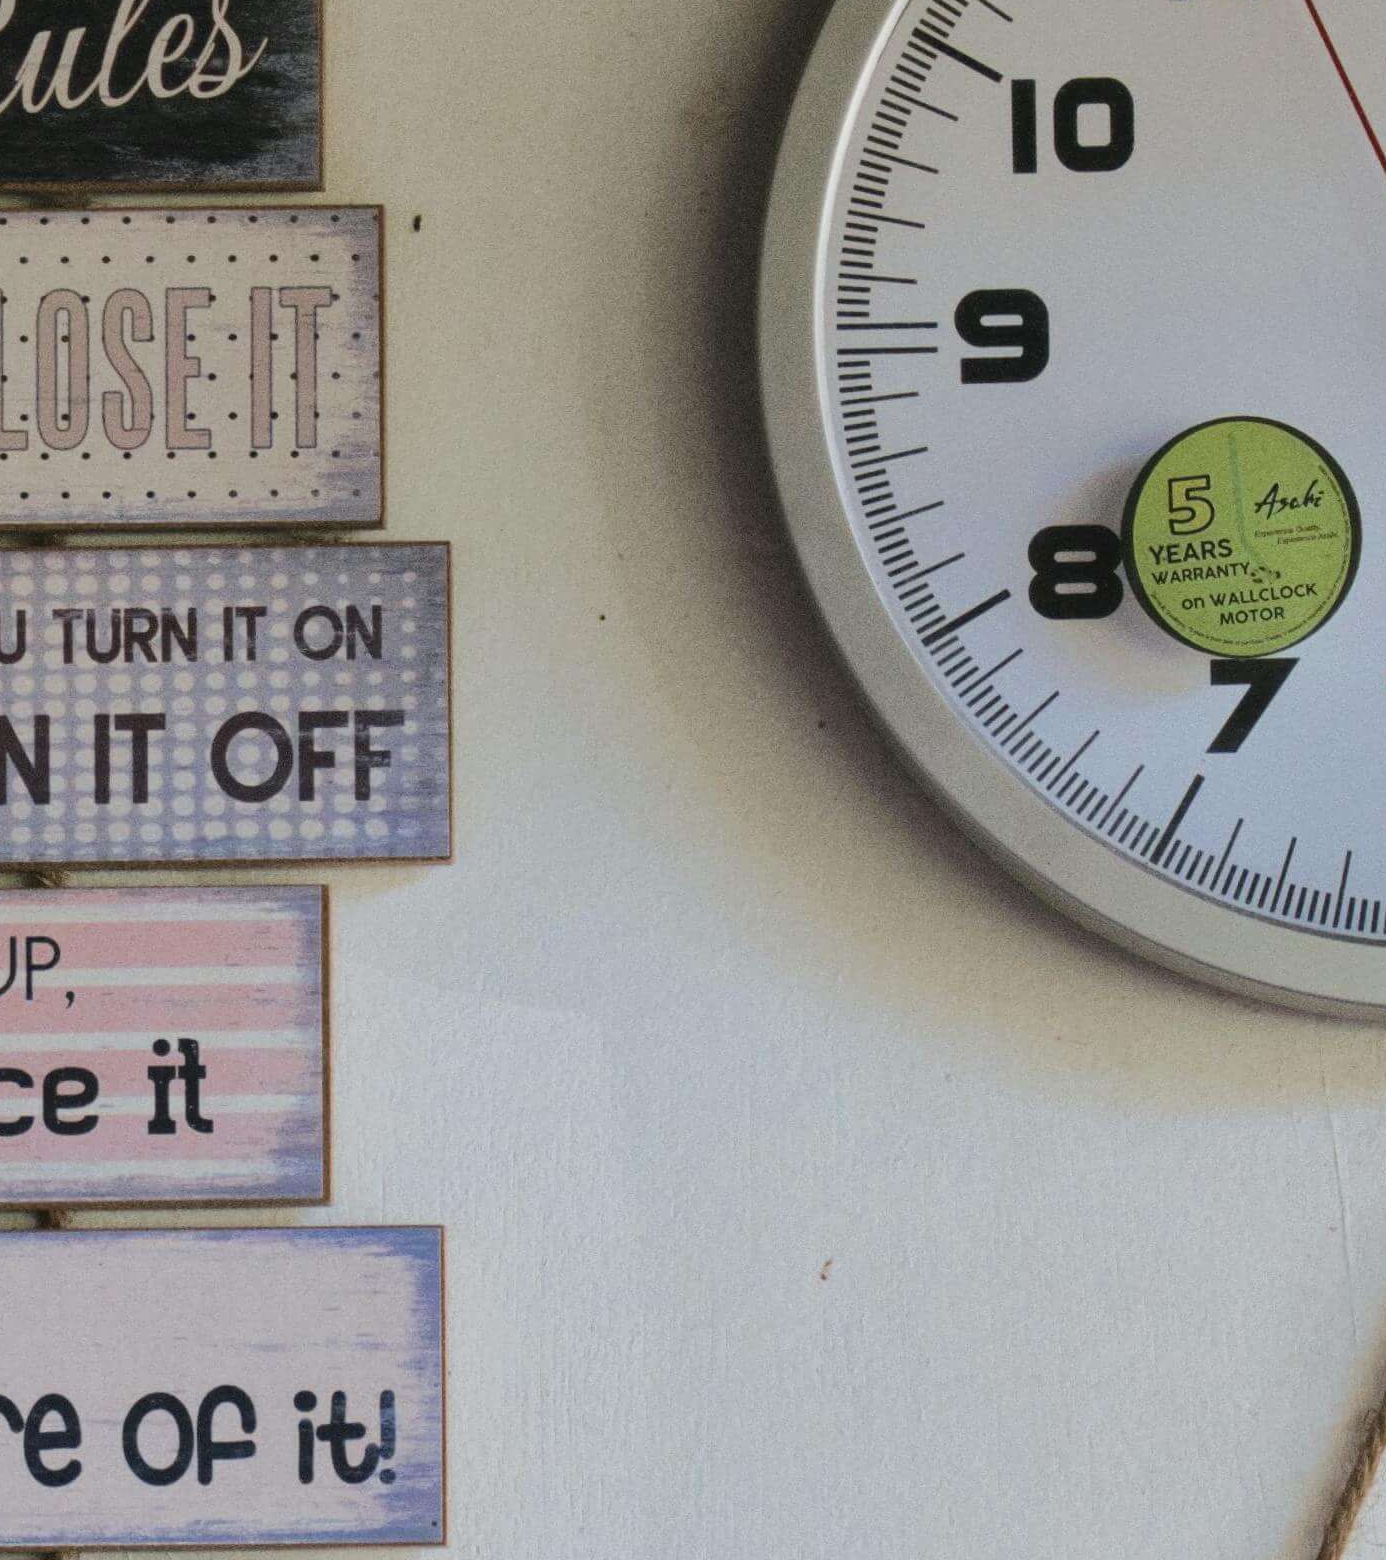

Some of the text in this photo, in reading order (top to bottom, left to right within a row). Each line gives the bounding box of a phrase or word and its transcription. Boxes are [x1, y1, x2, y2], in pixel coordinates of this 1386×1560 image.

[1009, 76, 1135, 174] 10
[249, 284, 334, 452] IT
[953, 288, 1051, 385] 9
[1168, 474, 1215, 535] 5
[1254, 479, 1325, 520] Asahi
[1027, 524, 1126, 621] 8
[1149, 539, 1233, 565] YEARS
[1151, 562, 1250, 585] WARRANTY
[1182, 583, 1318, 610] on WALLCLOCK
[52, 608, 199, 666] TURN
[220, 605, 274, 663] IT
[294, 603, 384, 662] ON
[1219, 606, 1285, 626] MOTOR
[1205, 654, 1300, 754] 7
[90, 711, 166, 806] IT
[211, 707, 408, 806] OFF
[144, 1039, 215, 1135] it
[293, 1390, 401, 1487] it!
